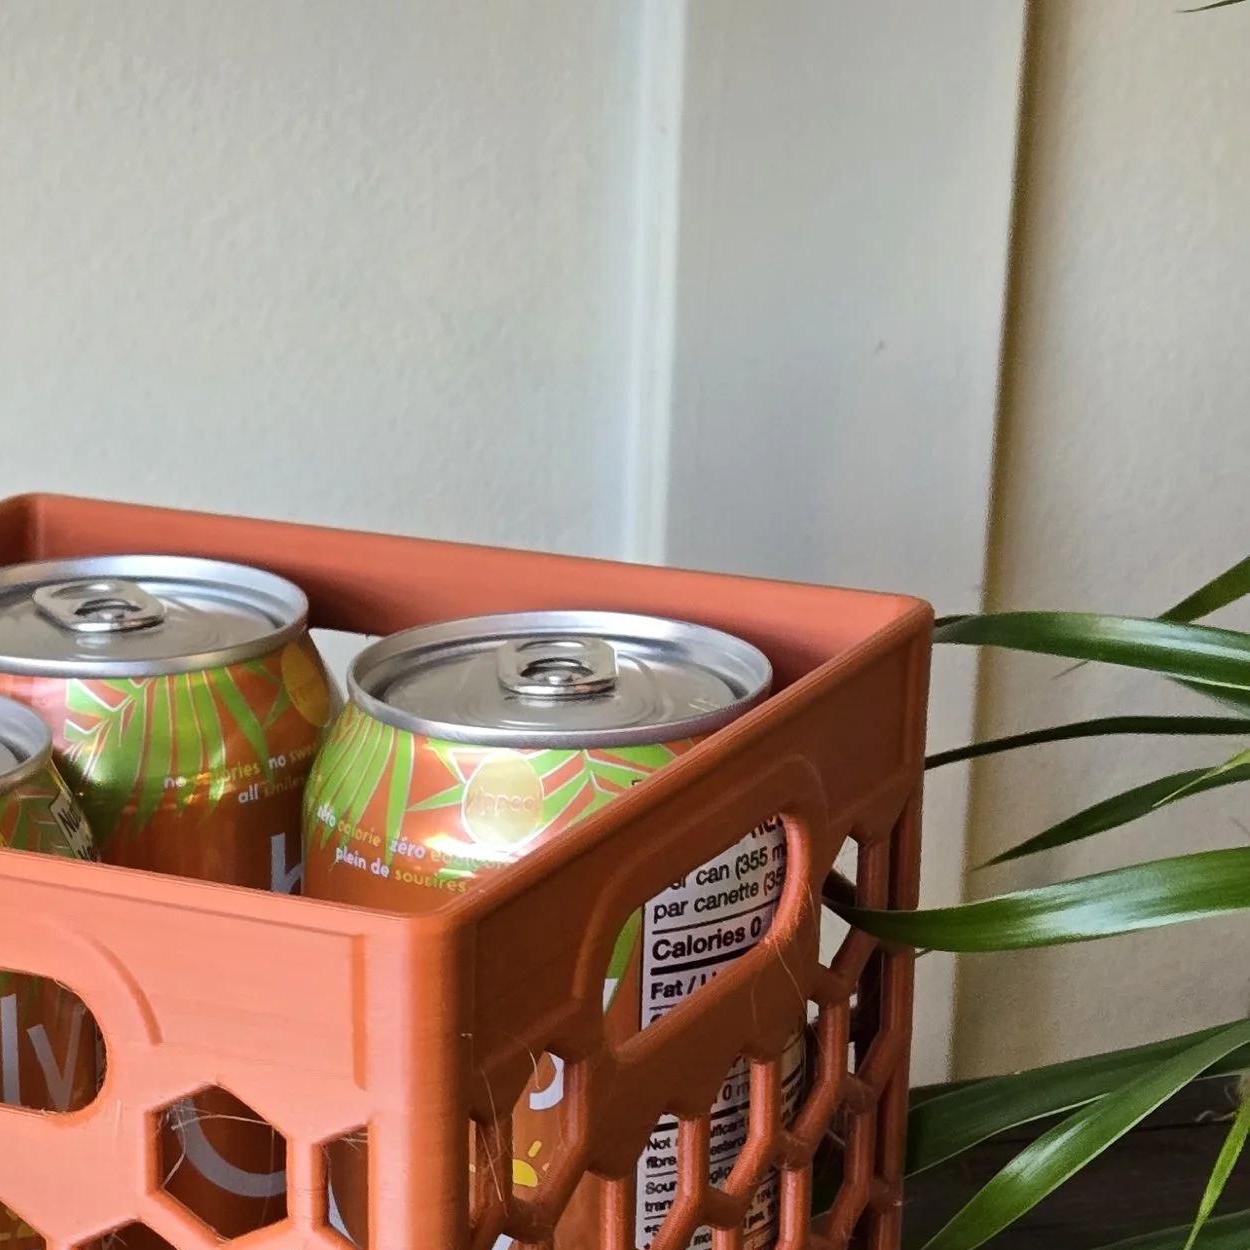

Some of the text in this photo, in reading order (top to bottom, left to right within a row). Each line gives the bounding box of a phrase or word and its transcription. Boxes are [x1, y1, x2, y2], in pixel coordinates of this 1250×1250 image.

[268, 754, 287, 770] no
[237, 783, 259, 804] all
[335, 845, 368, 874] plein
[370, 855, 391, 879] de
[695, 863, 731, 886] can
[734, 846, 769, 881] (355
[652, 899, 689, 924] par
[693, 880, 760, 914] canette
[762, 866, 784, 895] (35
[651, 915, 763, 962] Calories 0
[650, 979, 684, 1001] Fat
